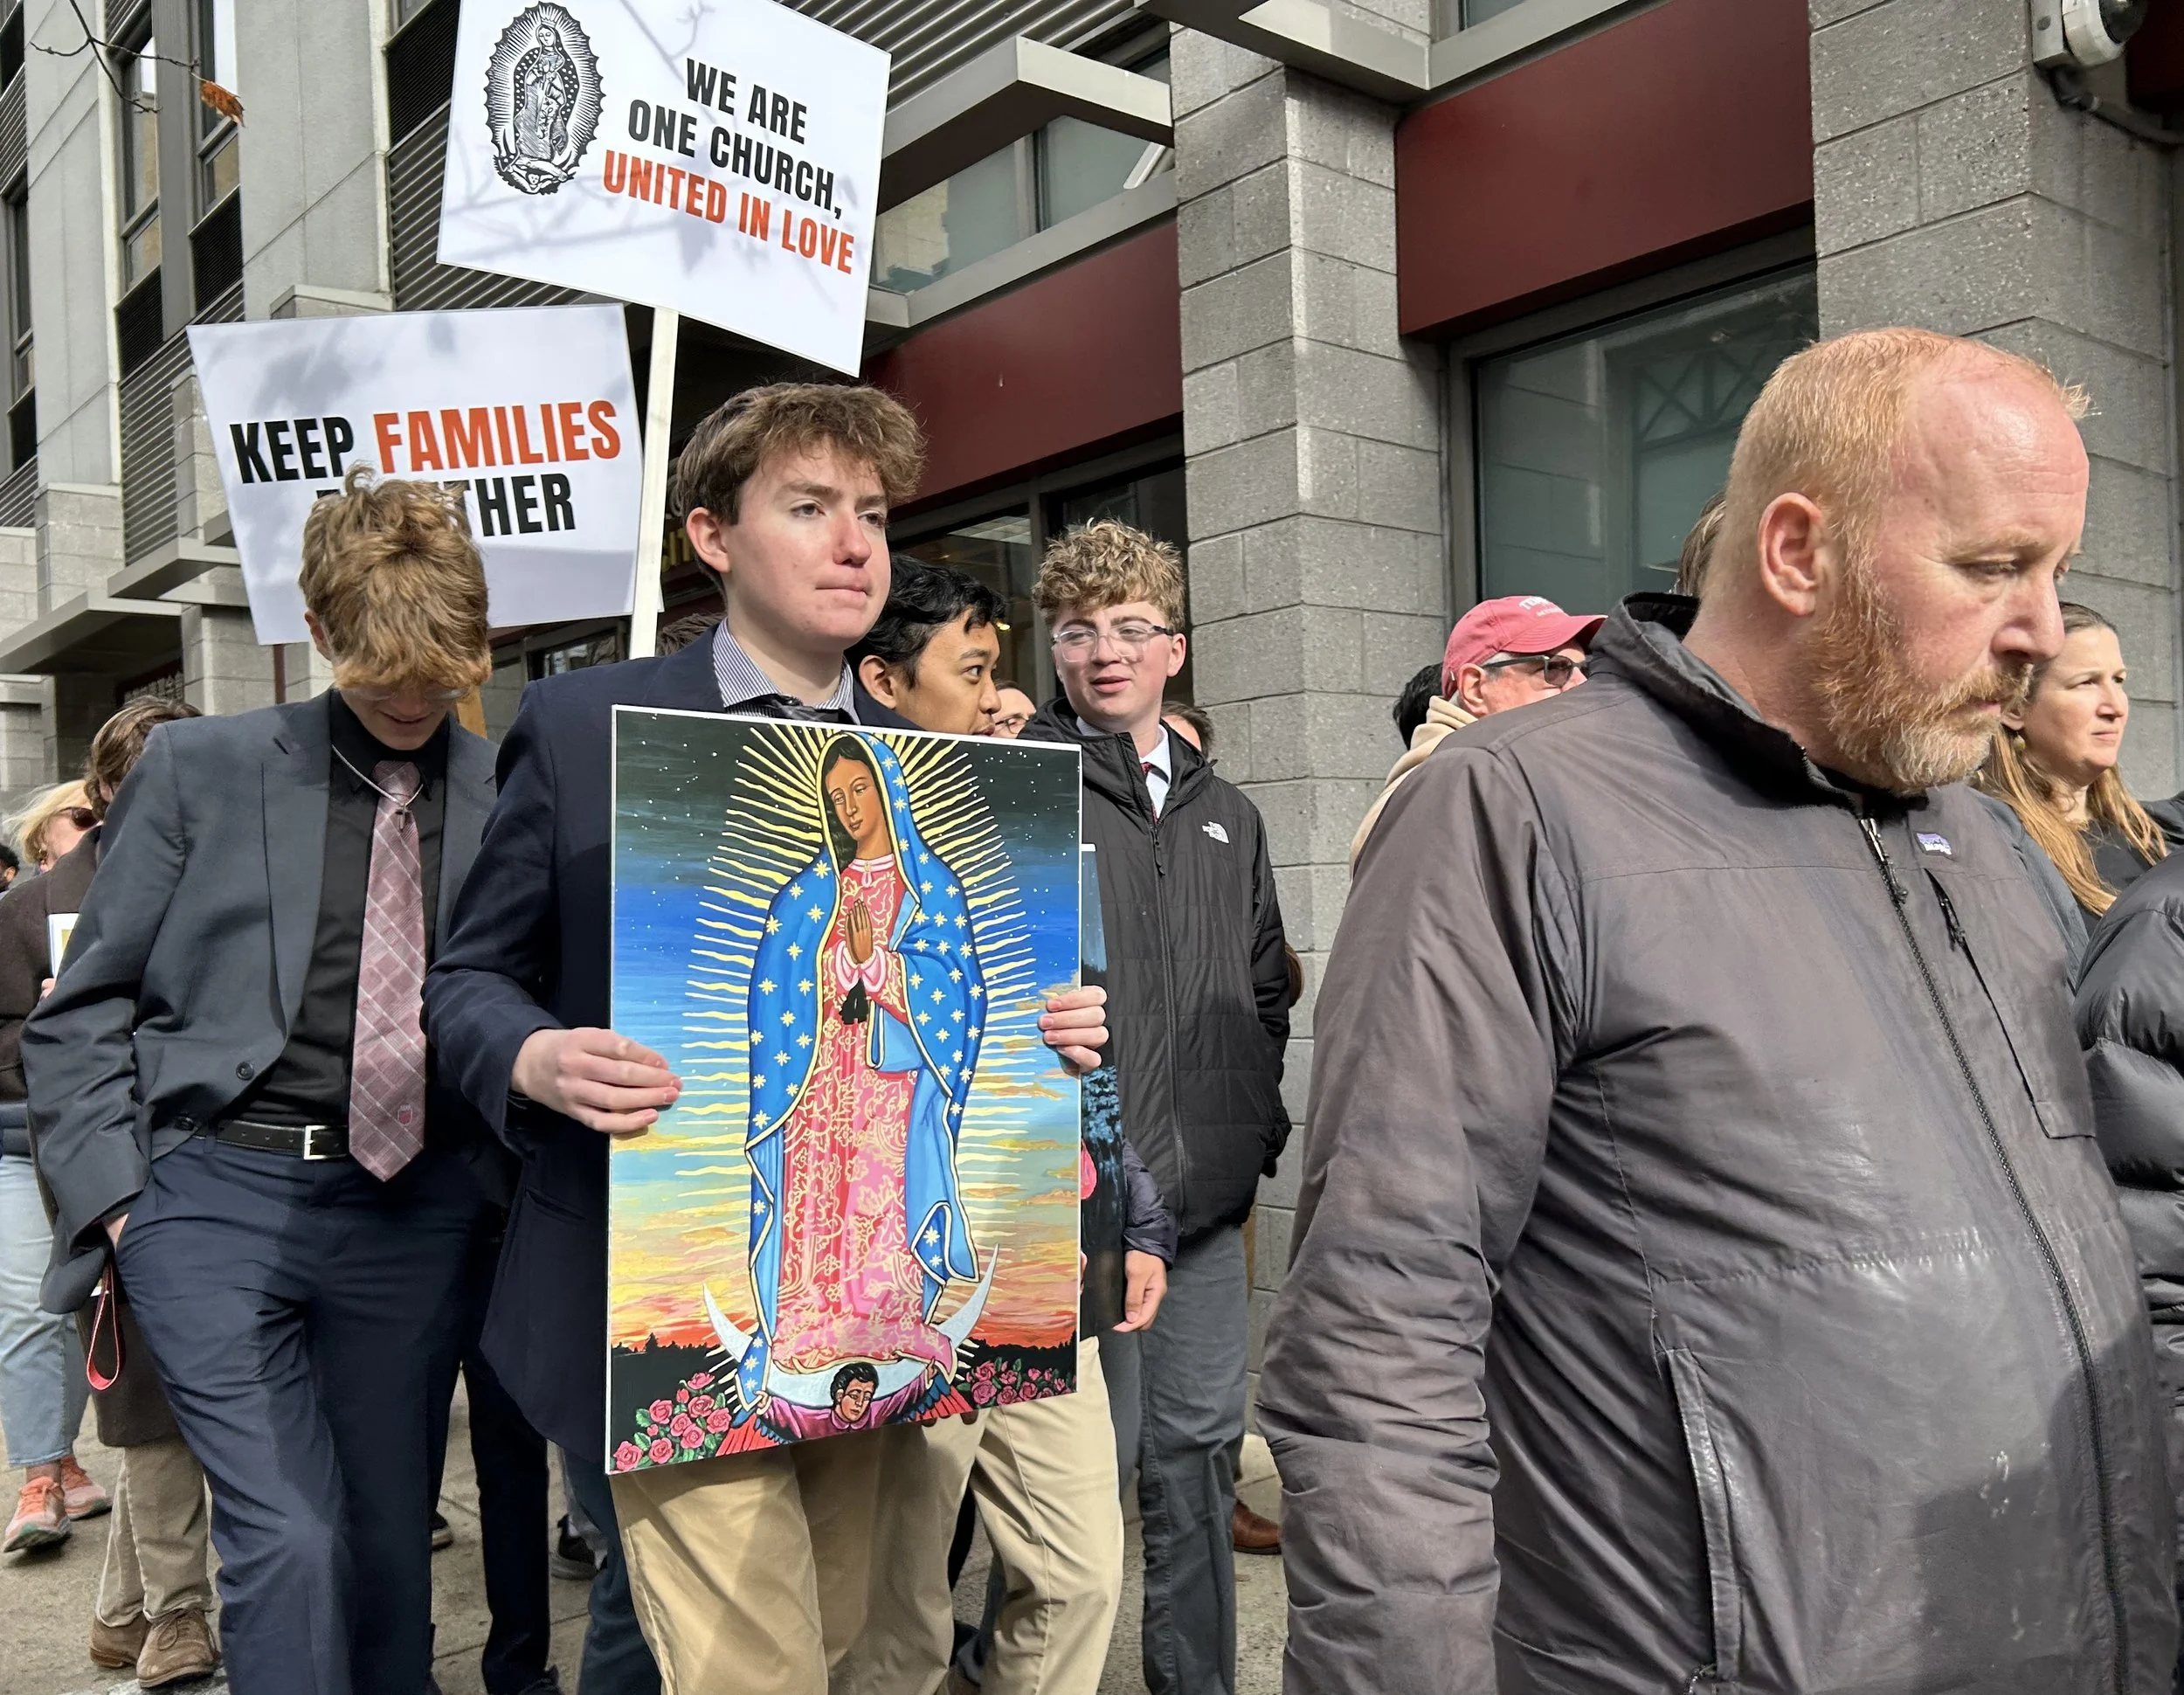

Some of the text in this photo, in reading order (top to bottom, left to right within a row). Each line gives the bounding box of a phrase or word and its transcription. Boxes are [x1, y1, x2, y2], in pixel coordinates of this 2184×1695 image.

[687, 58, 807, 145] WE ARE
[628, 99, 842, 220] ONE CHURCH,
[603, 149, 854, 275] UNITED IN LOVE
[229, 399, 622, 484] KEEP FAMILIES
